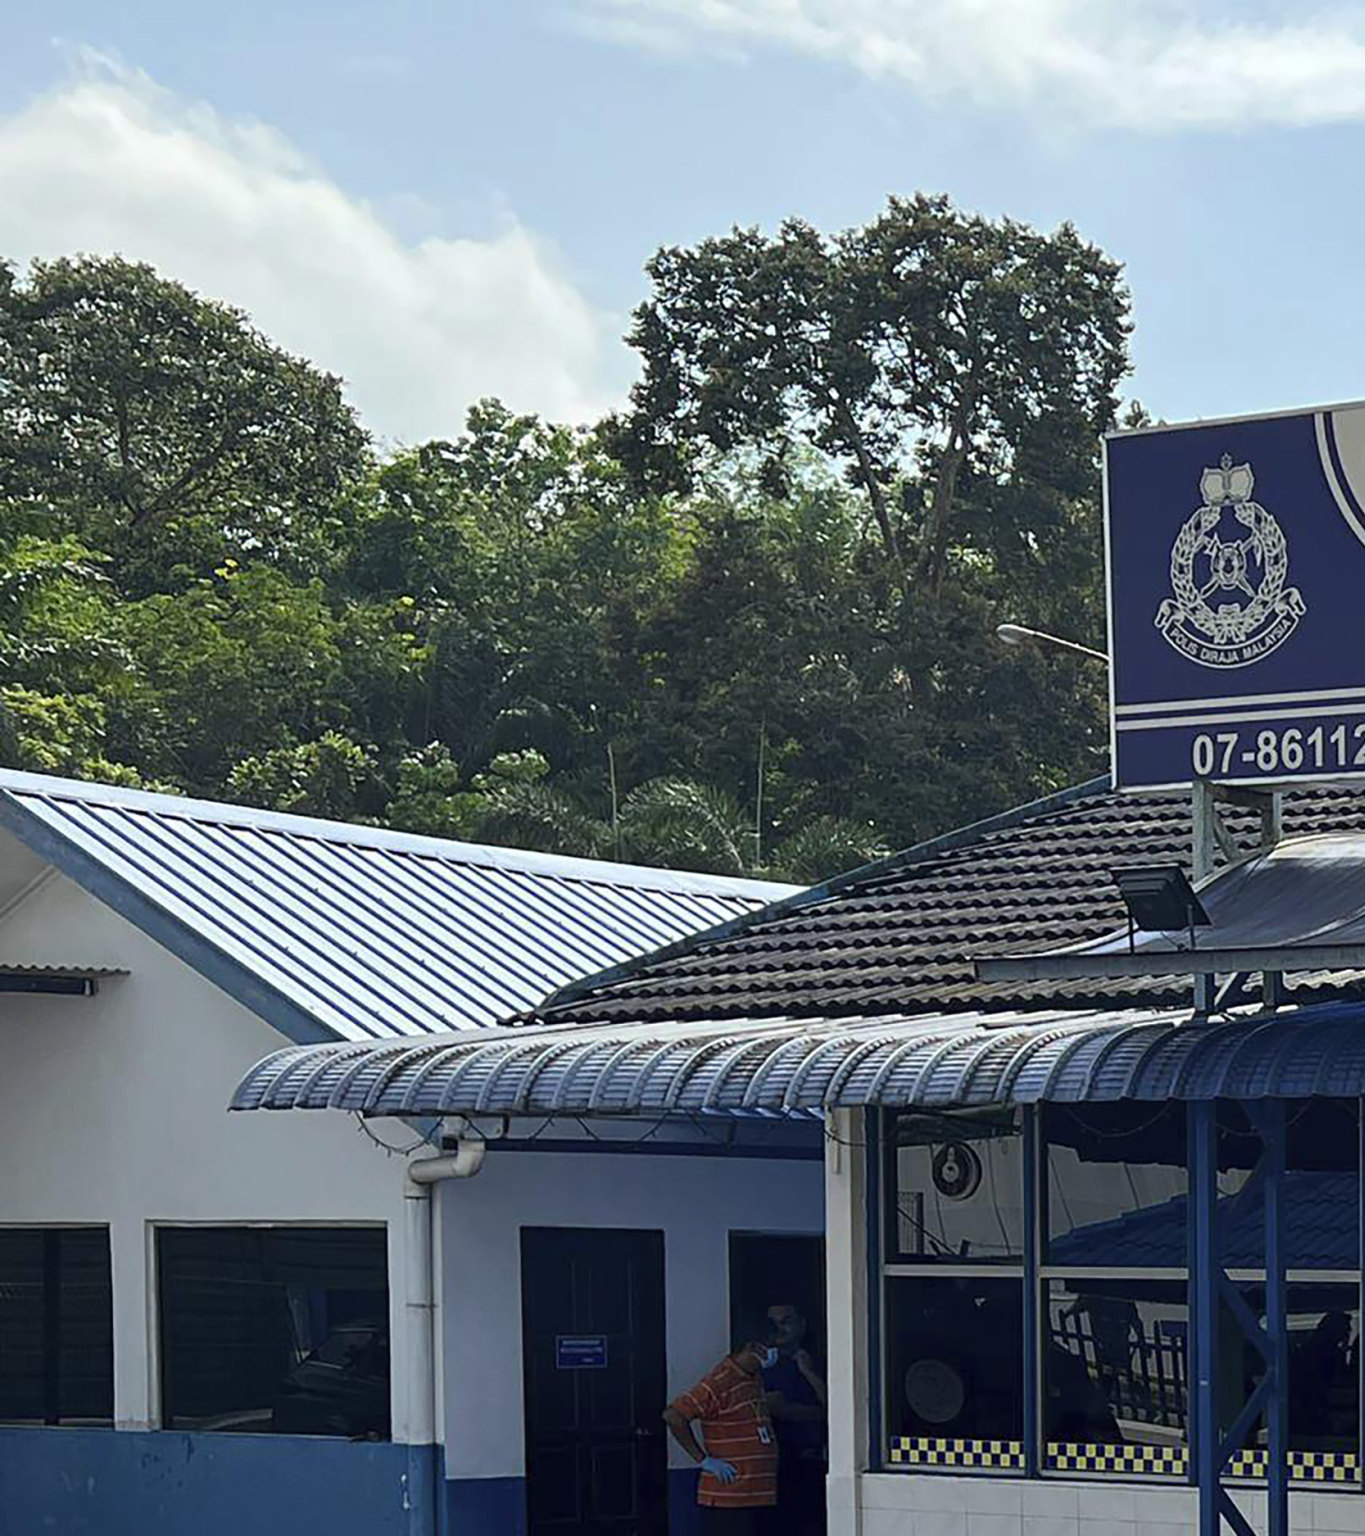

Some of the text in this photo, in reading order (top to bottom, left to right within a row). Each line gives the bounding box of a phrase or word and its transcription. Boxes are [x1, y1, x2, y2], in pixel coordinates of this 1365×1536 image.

[1169, 619, 1291, 663] POLIS DIRAJA MALAYSIA
